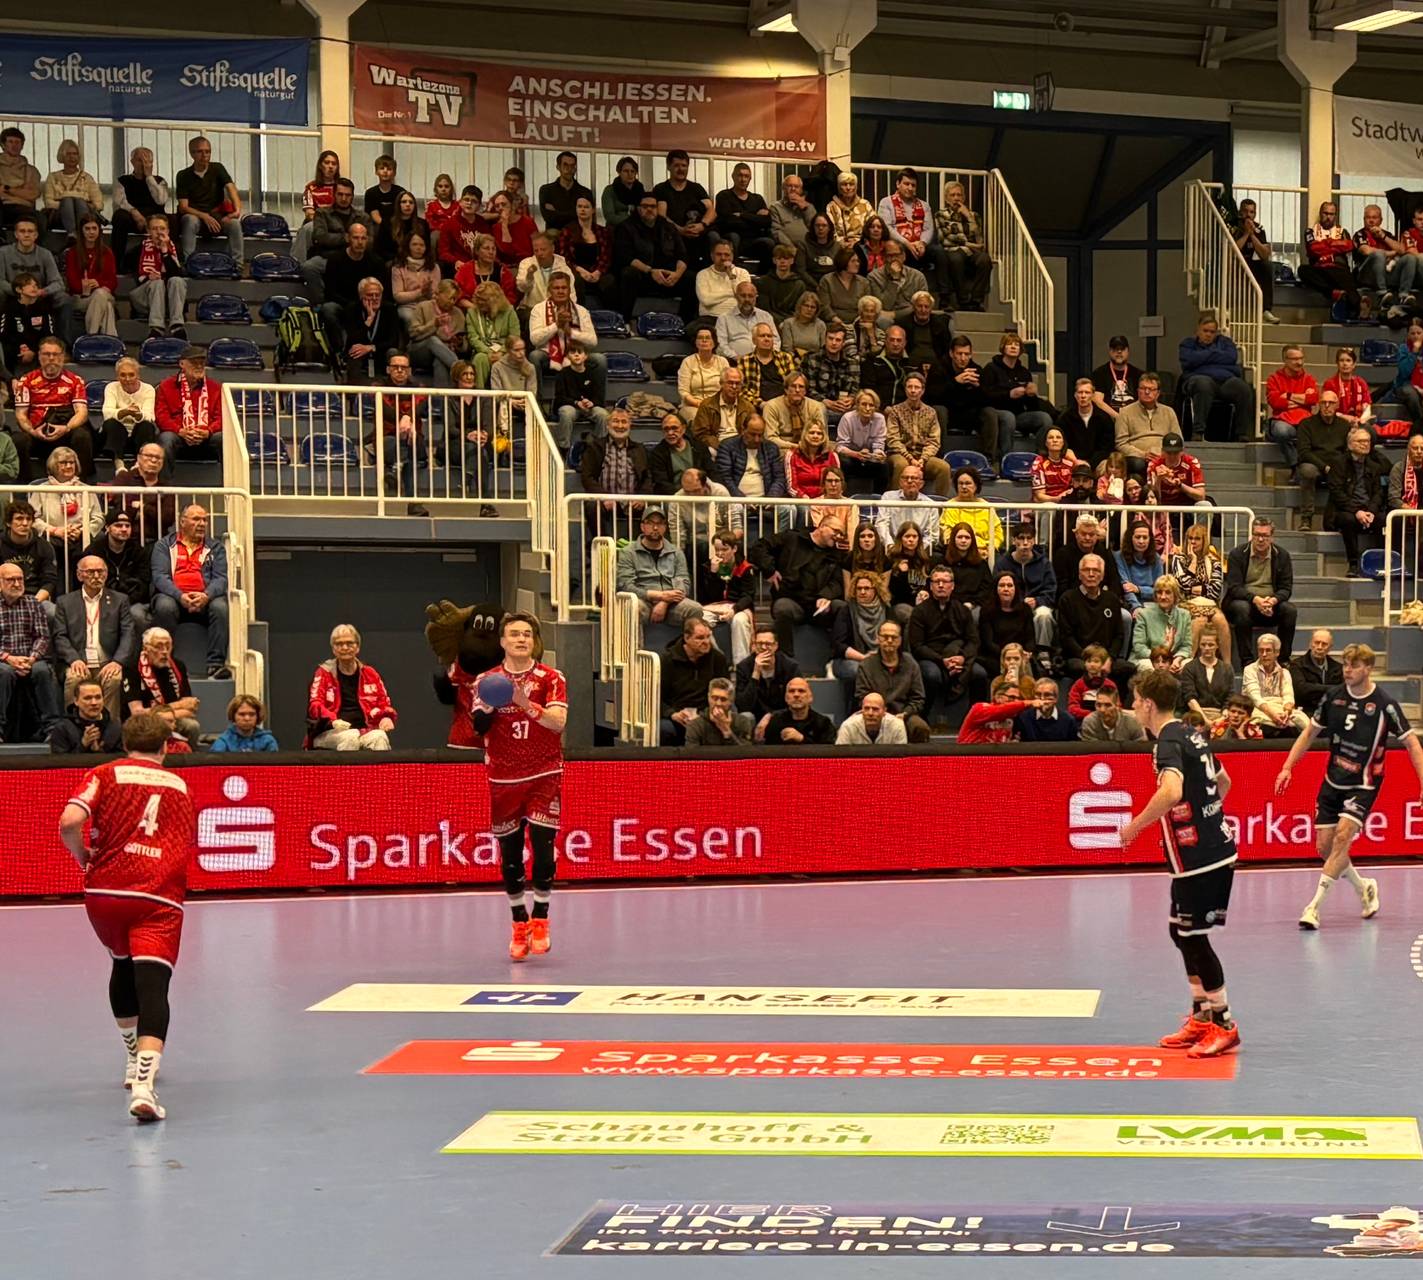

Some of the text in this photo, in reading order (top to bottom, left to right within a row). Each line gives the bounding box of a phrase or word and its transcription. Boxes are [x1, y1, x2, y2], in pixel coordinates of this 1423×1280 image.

[30, 52, 153, 88] Stiftsquelle
[179, 60, 298, 92] Stiftsquelle
[369, 64, 462, 95] Wartezone
[108, 84, 153, 95] naturgut
[253, 89, 295, 101] naturgut
[508, 75, 712, 103] ANSCHLIESSEN.
[408, 89, 463, 127] TV
[507, 97, 697, 124] EINSCHALTEN.
[508, 115, 601, 143] LÄUFT!
[708, 134, 816, 153] wartezone.tv
[511, 720, 530, 740] 37
[1344, 713, 1357, 731] 5
[137, 793, 162, 837] 4
[1223, 802, 1388, 845] arkae
[309, 817, 763, 882] Sparkae Essen
[615, 992, 965, 1002] HANSEFIT
[591, 1050, 1164, 1067] Sparkasse Essen
[580, 1066, 1160, 1078] www.sparkasse-essen.de
[525, 1121, 867, 1133] Schauhoff &
[1116, 1125, 1284, 1140] LVM
[708, 1133, 873, 1143] GmbH
[1115, 1139, 1370, 1147] VERSICHERUNG
[614, 1204, 834, 1216] HIER
[603, 1215, 985, 1230] FINDEN!
[580, 1238, 1176, 1254] karriere-in-essen.de
